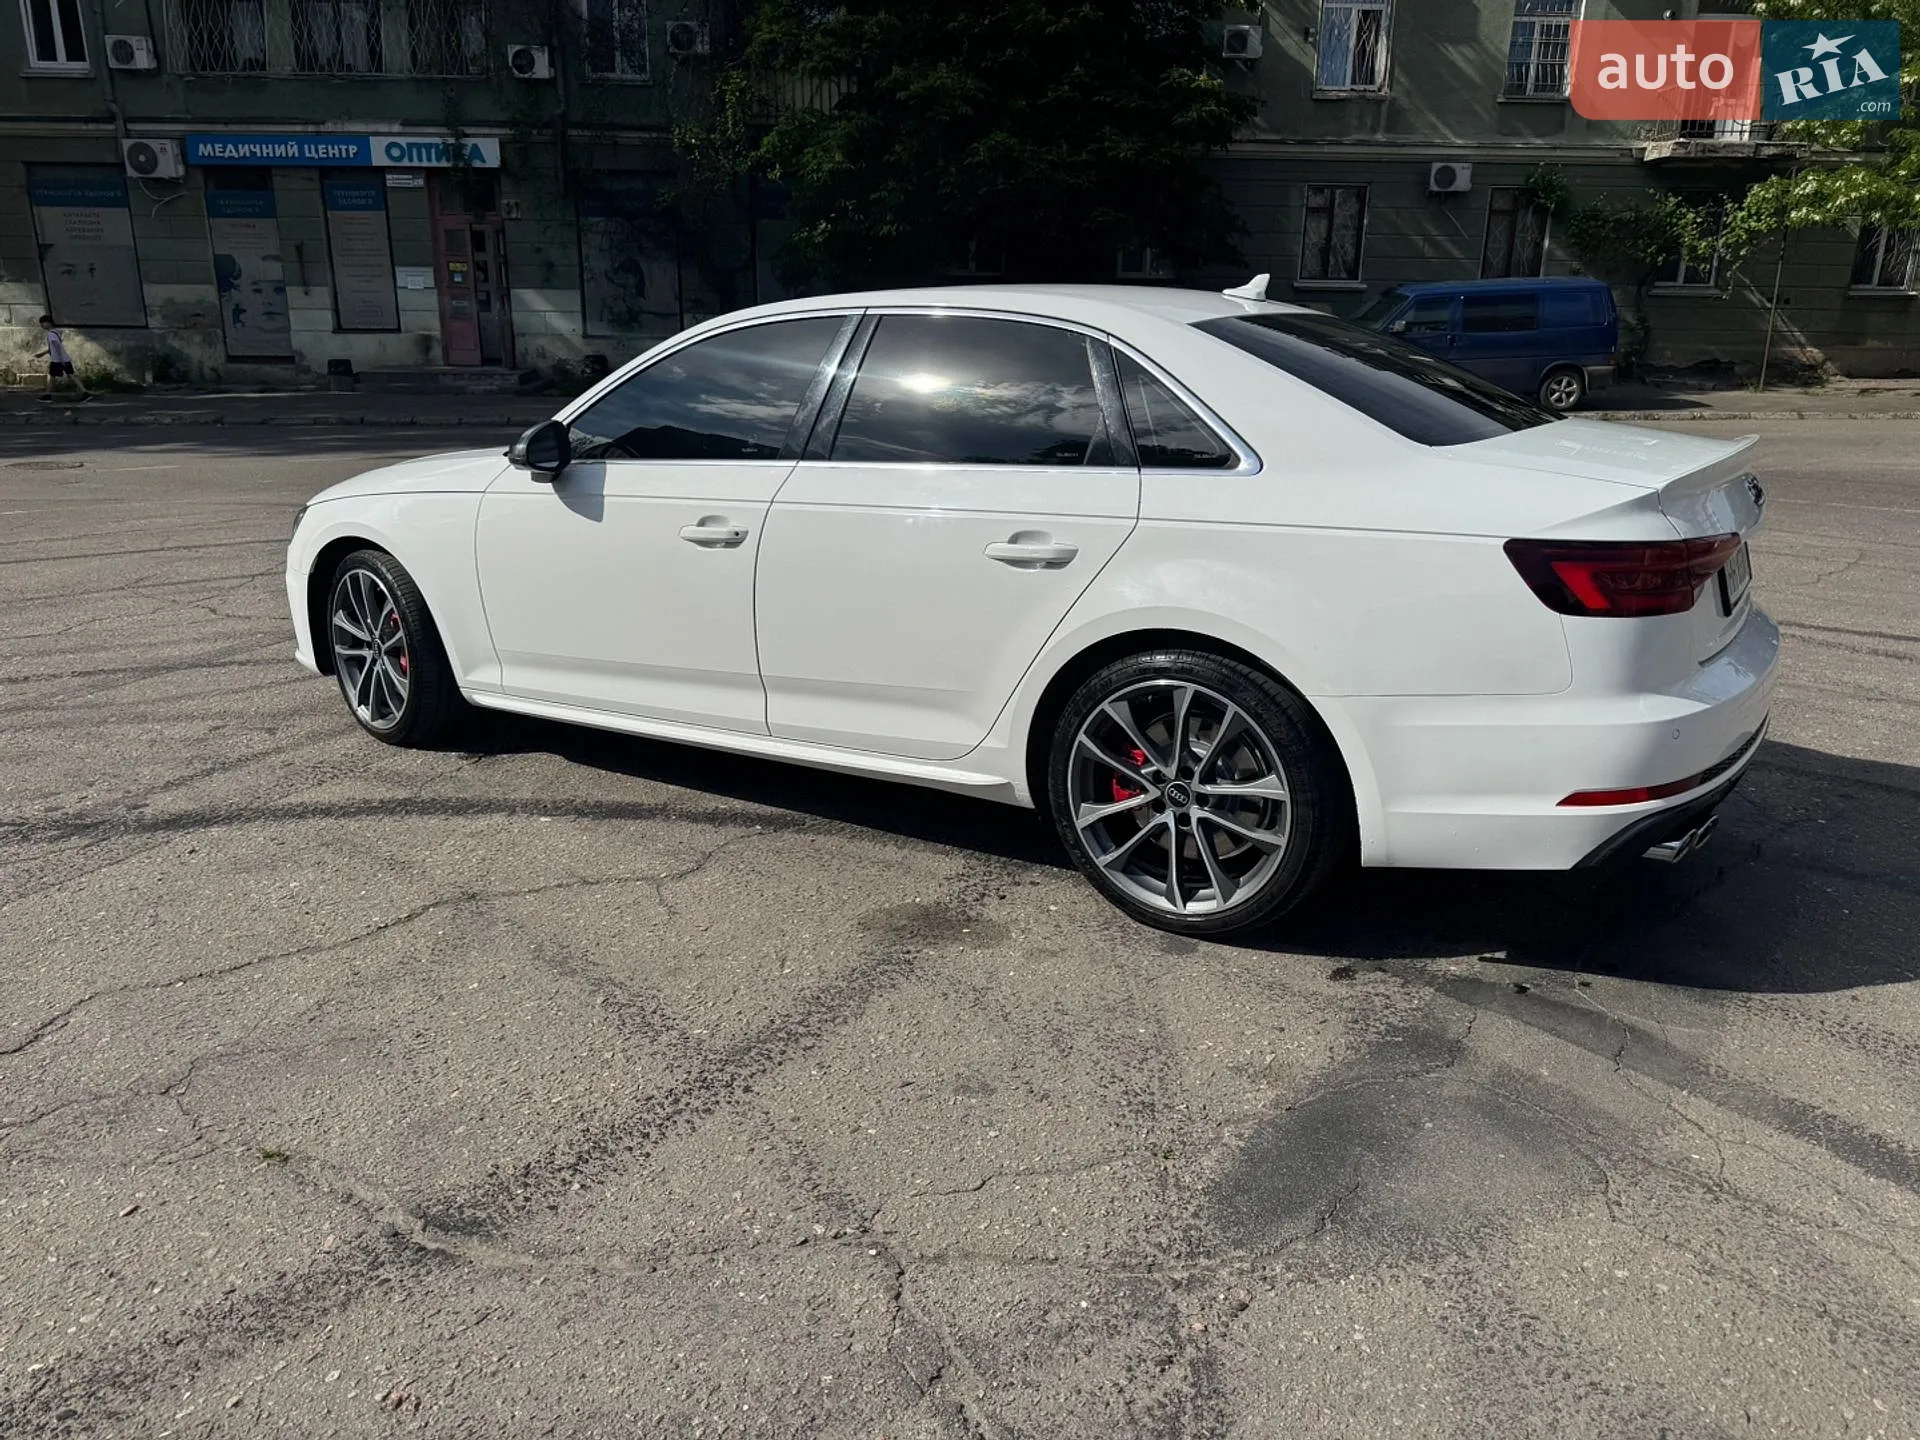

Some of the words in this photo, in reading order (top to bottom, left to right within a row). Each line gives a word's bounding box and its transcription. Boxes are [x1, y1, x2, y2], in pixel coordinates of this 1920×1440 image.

[198, 141, 299, 158] МЕДИЧНИЙ
[304, 144, 358, 160] ЦЕНТР
[385, 141, 487, 164] ОПТИА
